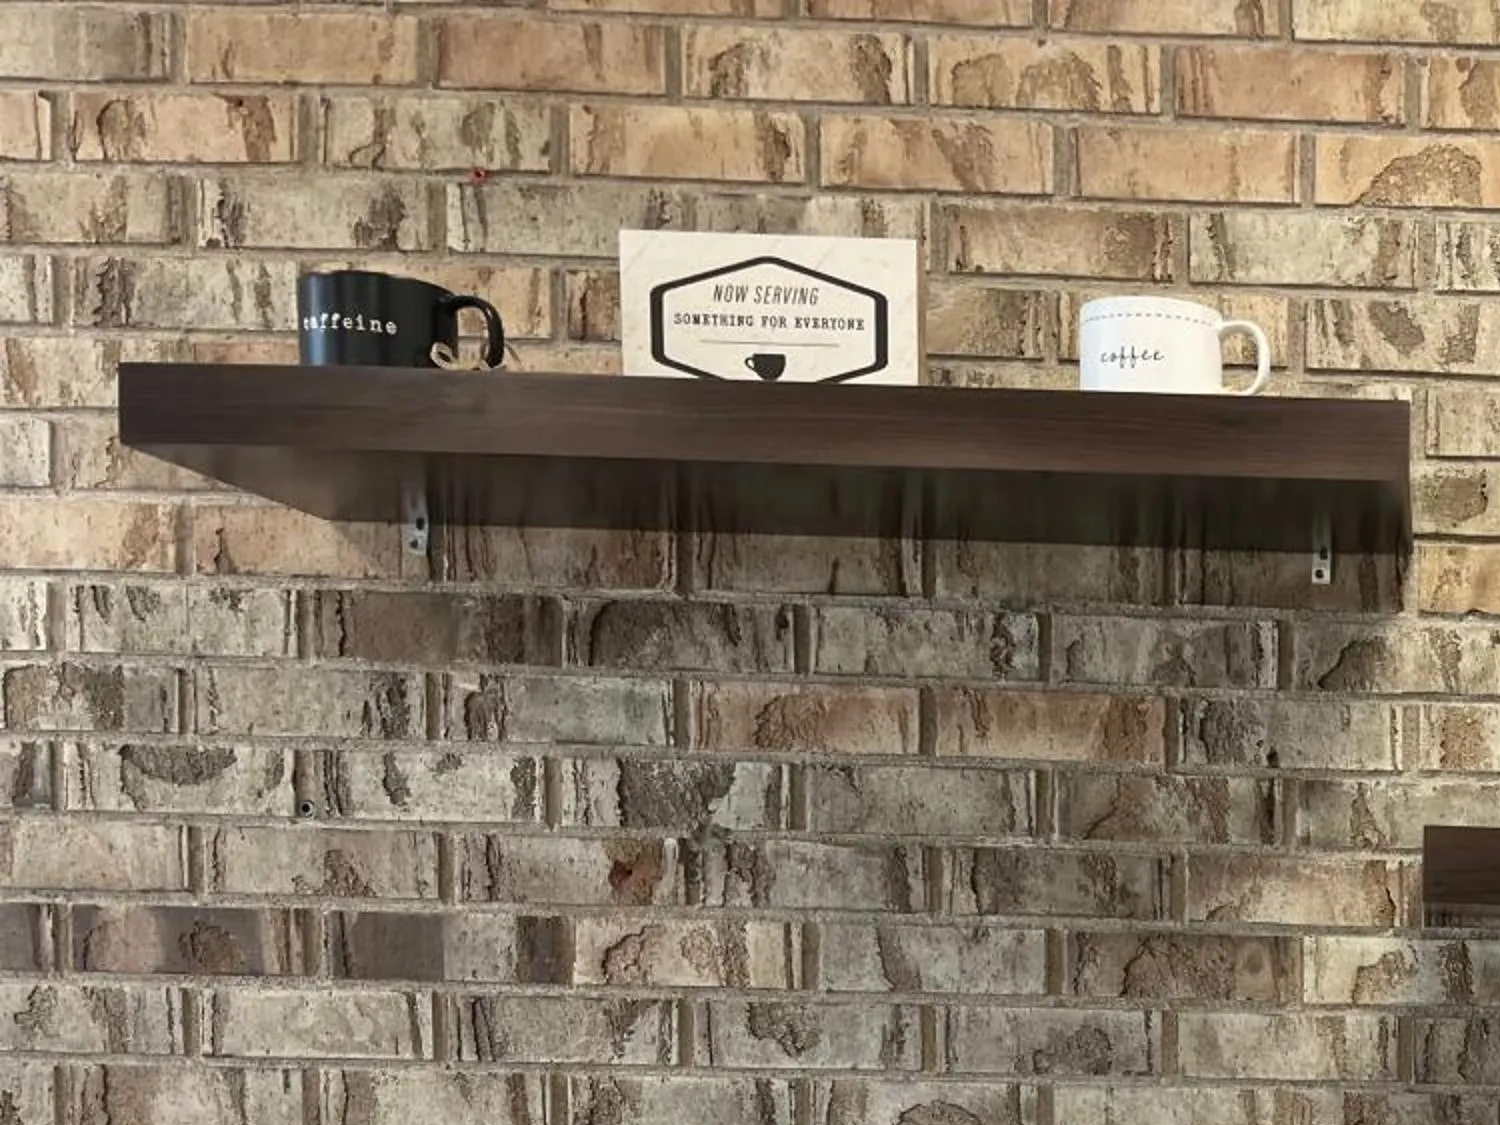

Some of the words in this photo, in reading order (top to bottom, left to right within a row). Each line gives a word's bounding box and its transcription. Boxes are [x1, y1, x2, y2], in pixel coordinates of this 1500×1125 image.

[712, 284, 749, 303] NOW
[753, 285, 820, 306] SERVING
[673, 313, 755, 328] SOMETHING
[760, 315, 788, 329] FOR
[794, 317, 866, 331] EVERYONE
[1100, 345, 1166, 369] coffee
